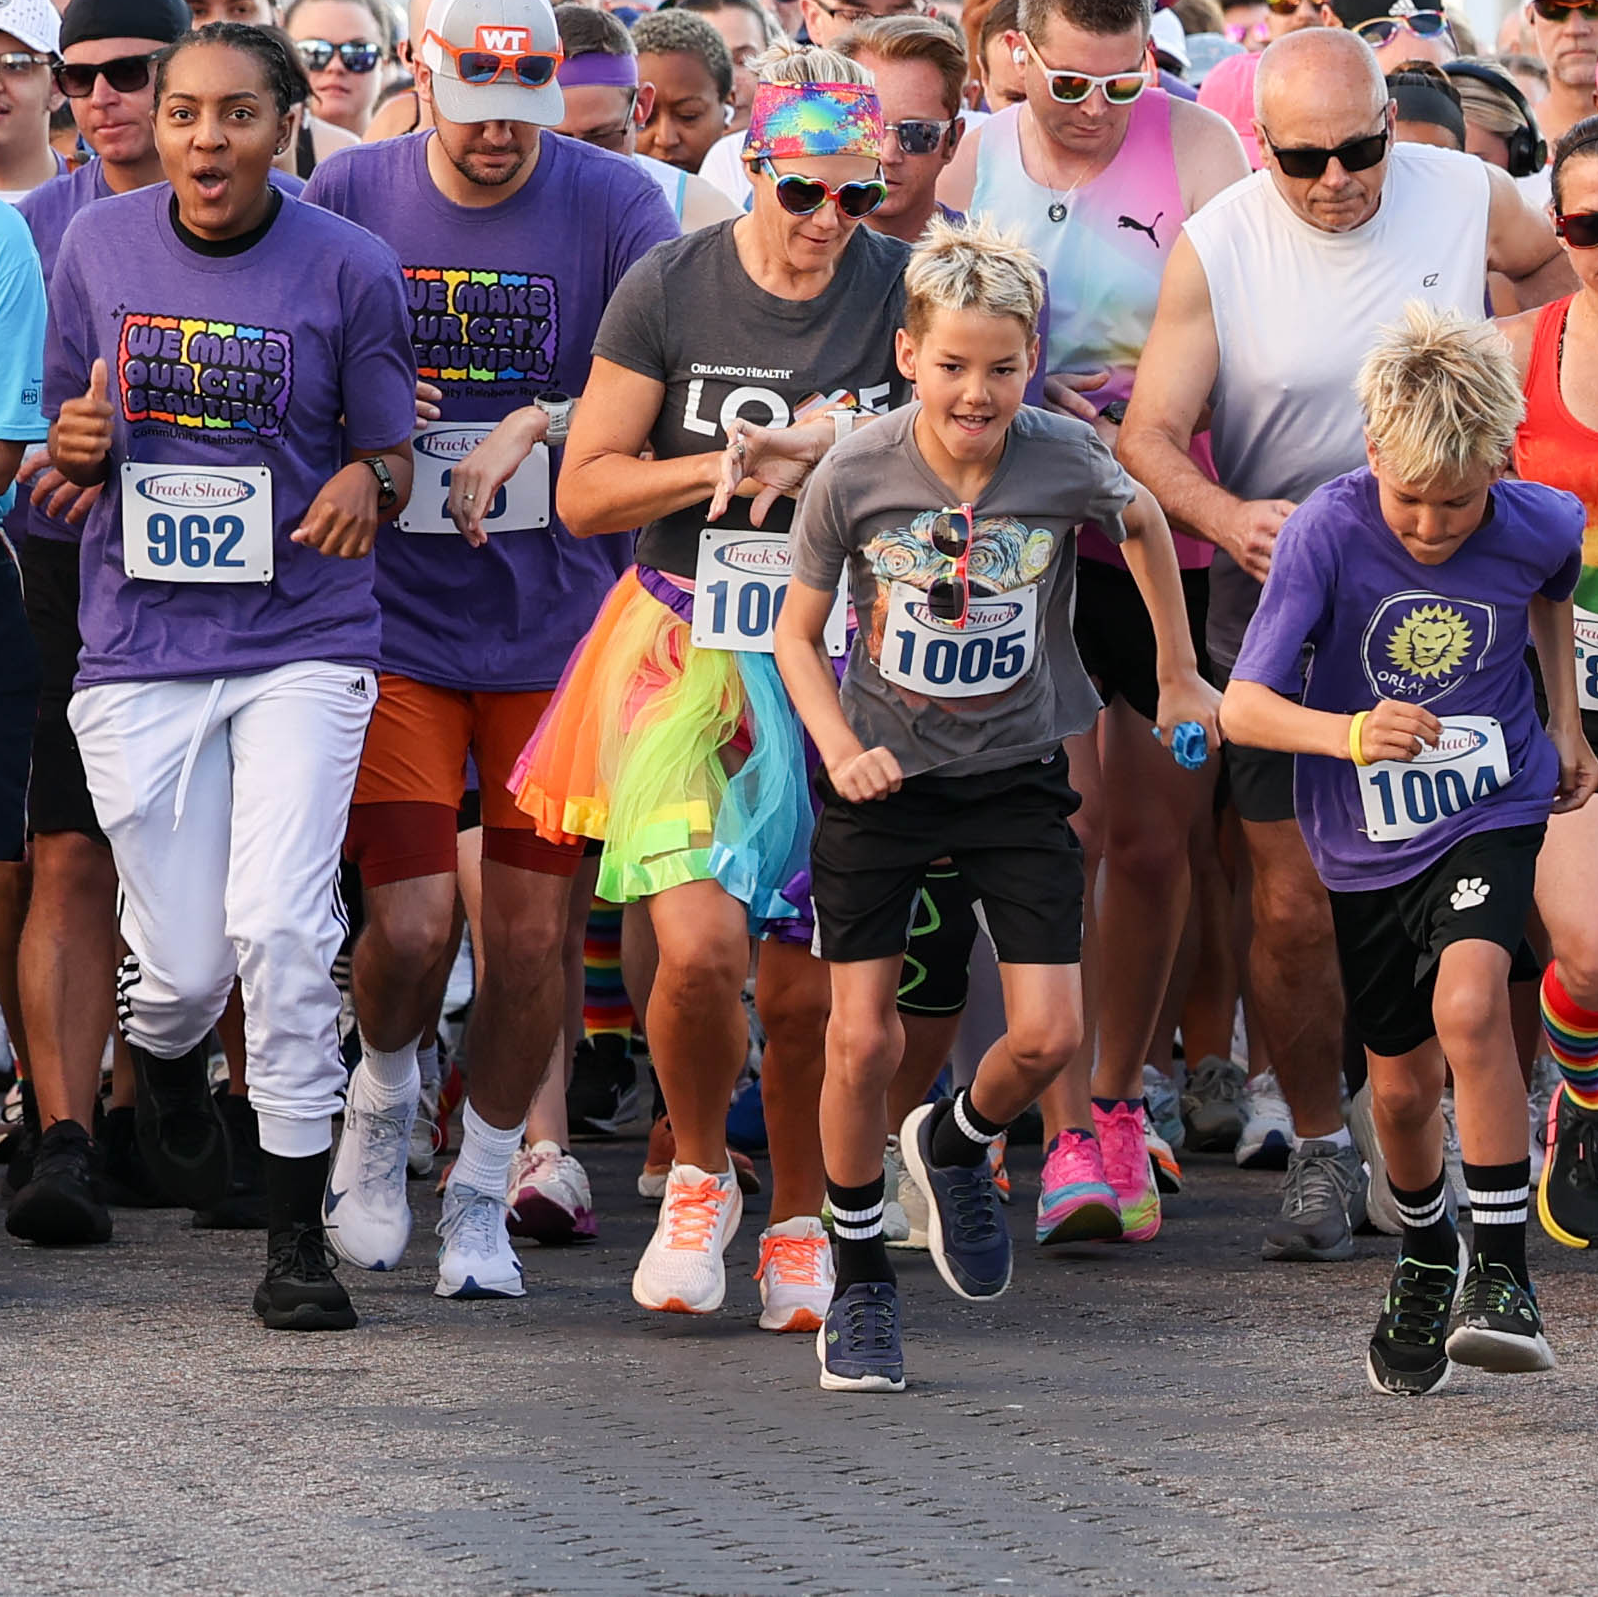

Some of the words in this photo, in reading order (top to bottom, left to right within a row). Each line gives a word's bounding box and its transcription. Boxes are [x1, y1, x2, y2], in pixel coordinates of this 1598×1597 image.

[482, 30, 527, 51] WT
[454, 282, 550, 316] MAKE
[408, 314, 462, 342] UR
[469, 317, 552, 348] CITY
[127, 325, 183, 359] WE
[189, 333, 286, 372] MAKE
[413, 343, 550, 374] EAUTIFUL
[125, 360, 194, 392] OUR
[201, 368, 285, 404] CITY
[691, 363, 745, 378] ORLANDO
[127, 388, 278, 428] BEAUTIFUL
[423, 434, 471, 451] Track
[145, 479, 192, 497] Track
[193, 482, 248, 499] Shack
[147, 513, 246, 568] 962
[725, 546, 773, 565] Track
[896, 629, 1027, 685] 1005
[1369, 765, 1501, 825] 1004
